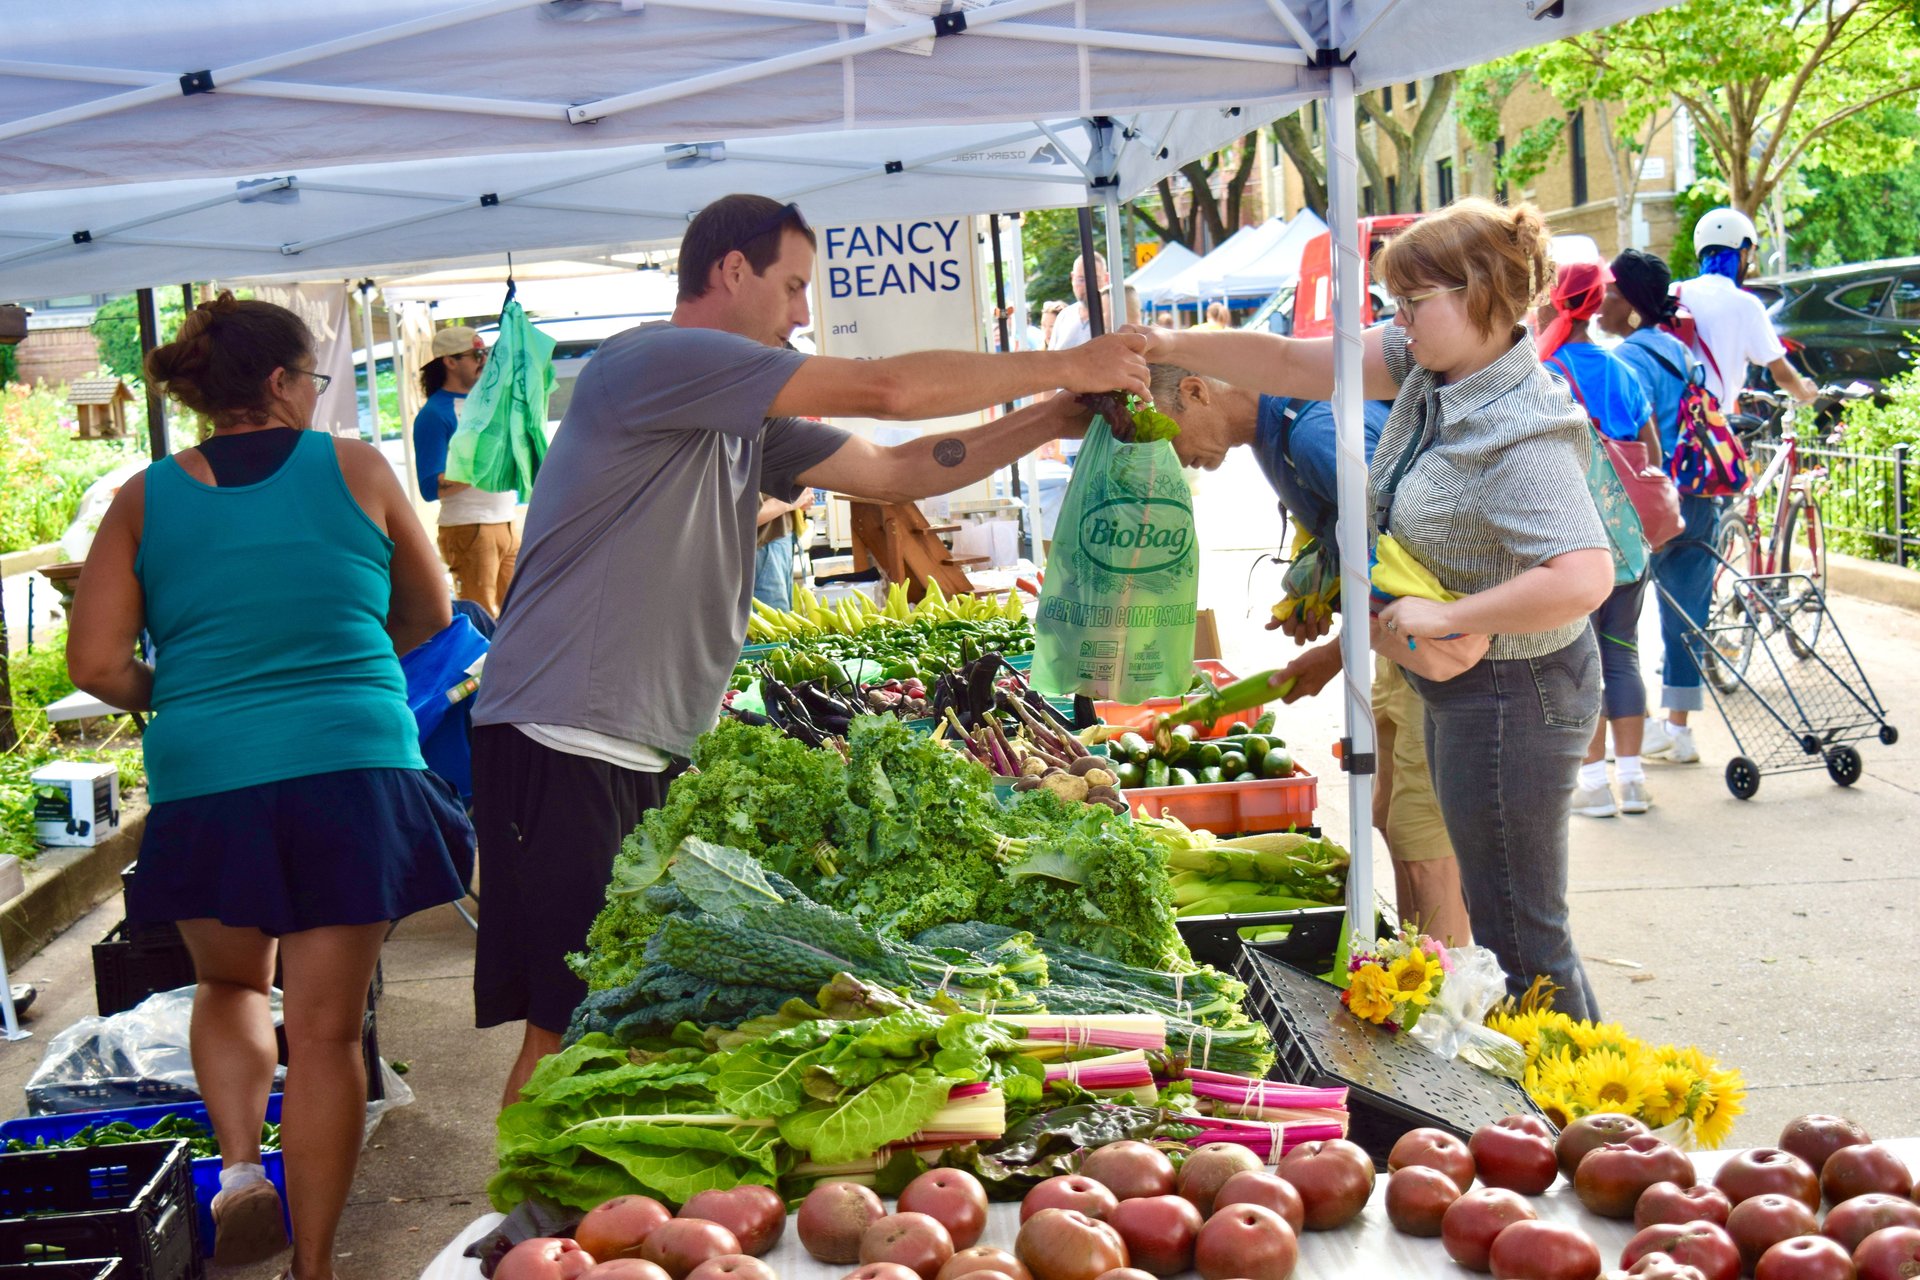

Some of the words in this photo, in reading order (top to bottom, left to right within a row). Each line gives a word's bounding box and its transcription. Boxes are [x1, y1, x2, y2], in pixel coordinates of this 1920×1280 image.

[826, 220, 960, 260] FANCY
[829, 259, 961, 298] BEANS
[832, 321, 858, 335] and
[1089, 518, 1188, 555] BioBag
[1044, 596, 1113, 628] CERTIFIED
[1115, 601, 1196, 628] COMPOSTABL
